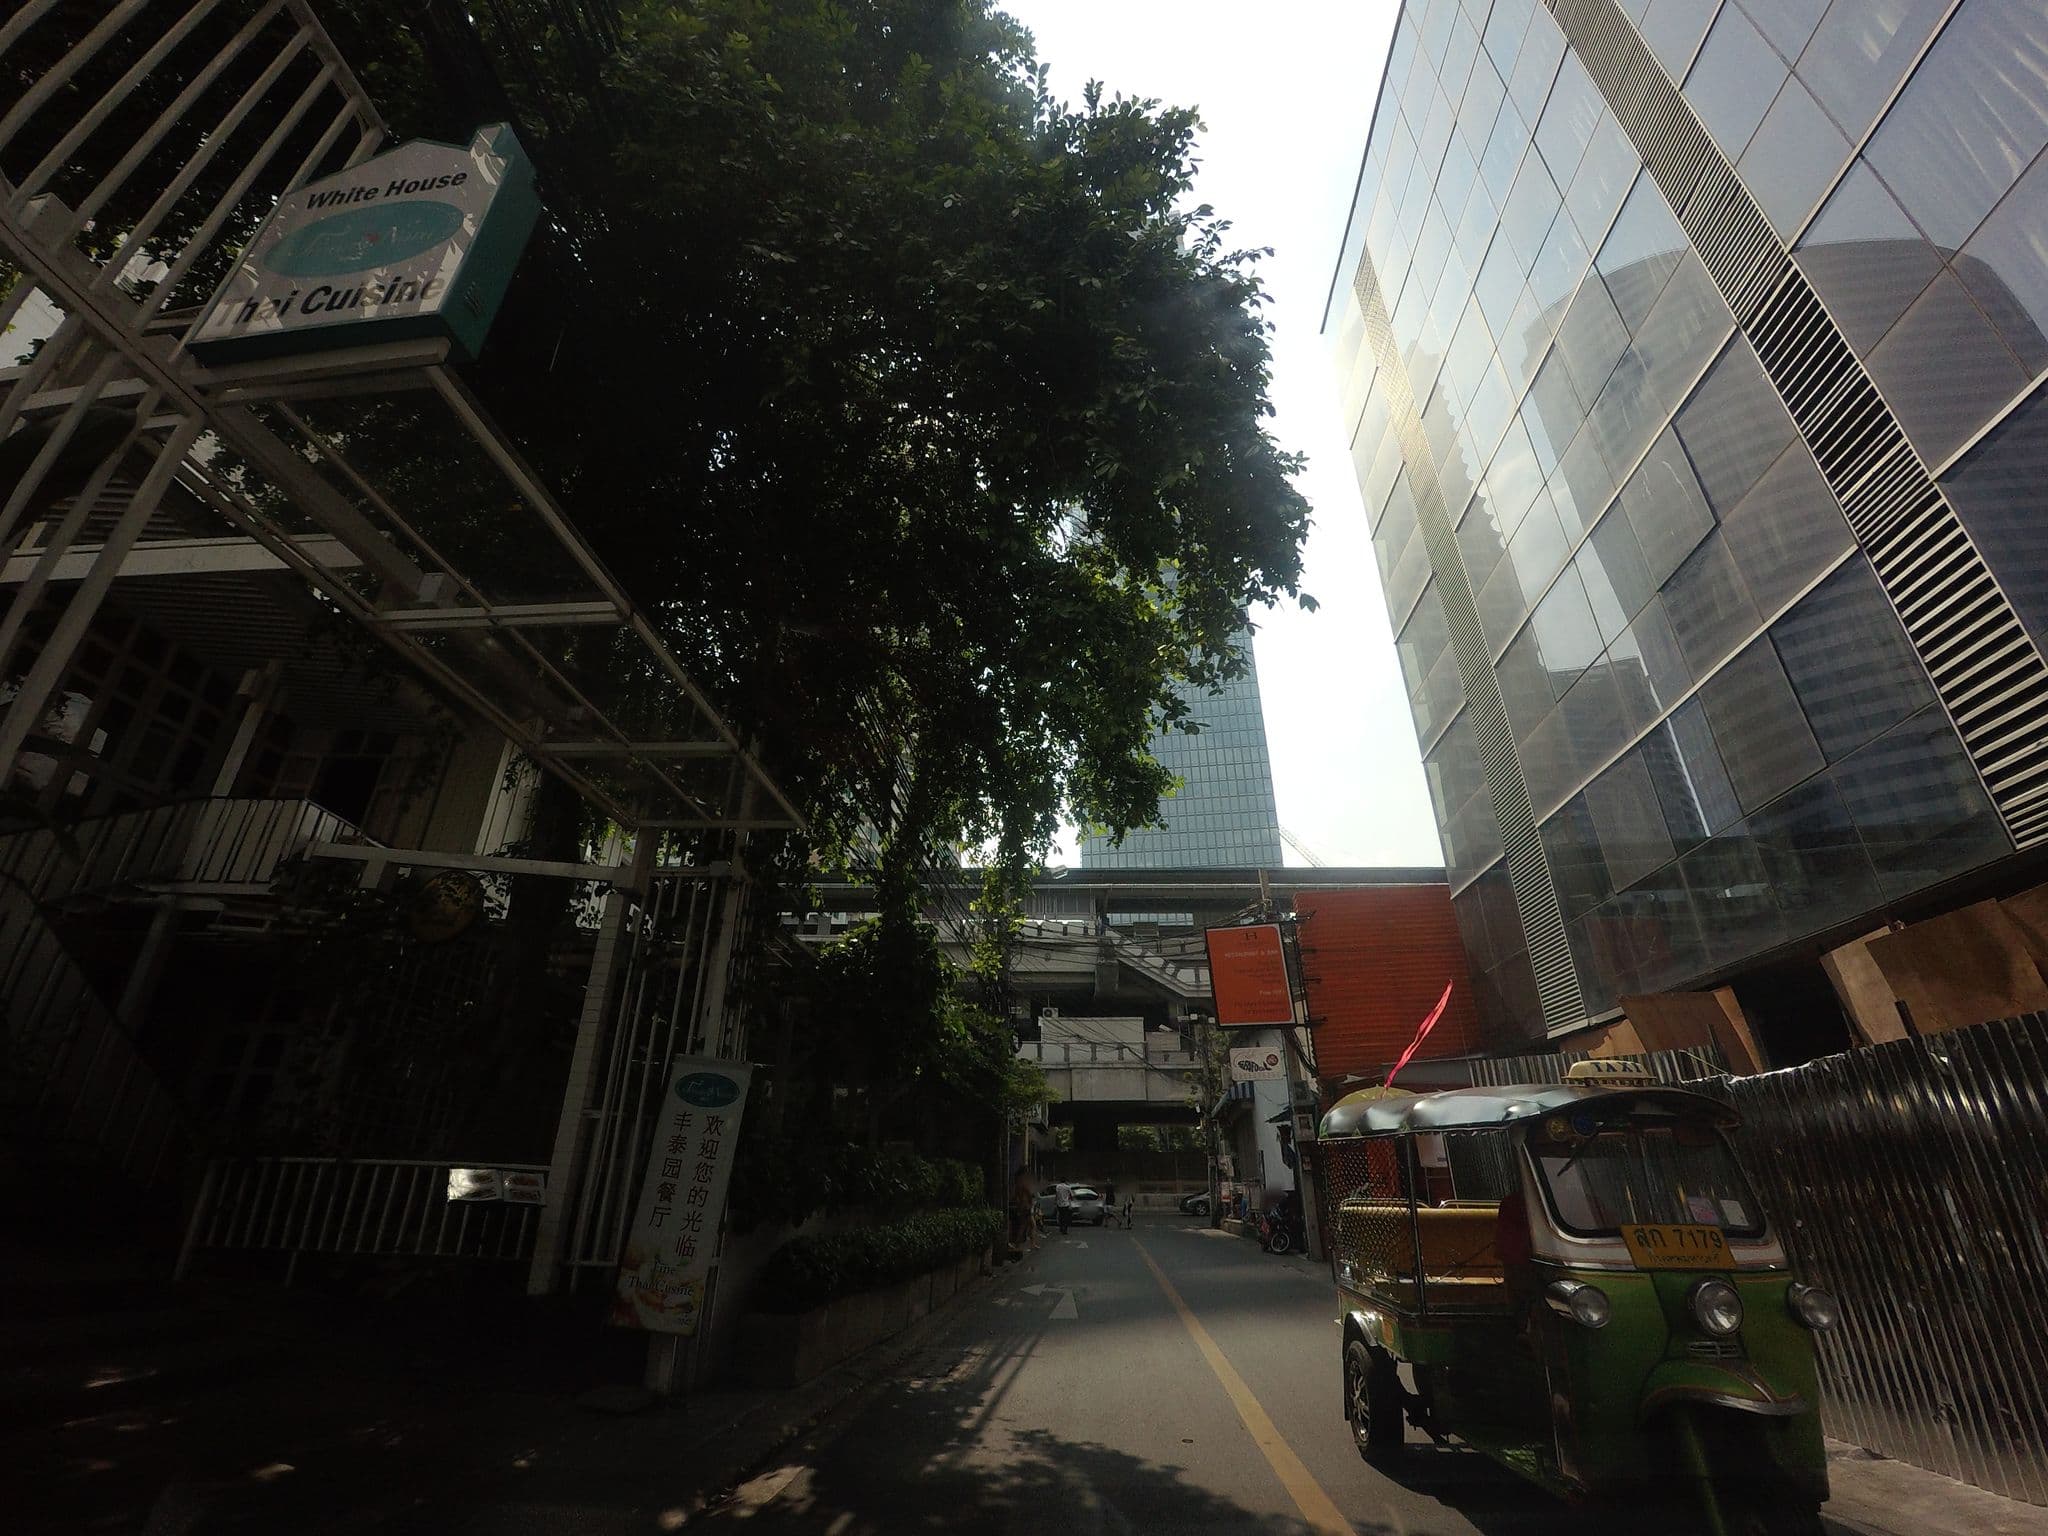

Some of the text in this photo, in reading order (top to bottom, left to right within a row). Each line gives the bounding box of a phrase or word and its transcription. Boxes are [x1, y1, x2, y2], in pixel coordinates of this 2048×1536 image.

[307, 170, 467, 209] White House
[215, 276, 446, 327] Thai Cuisine
[1590, 1062, 1642, 1073] TAXI
[648, 1111, 693, 1229] 丰泰园餐厅
[676, 1115, 724, 1257] 欢迎您的光临
[1671, 1228, 1722, 1249] 7179
